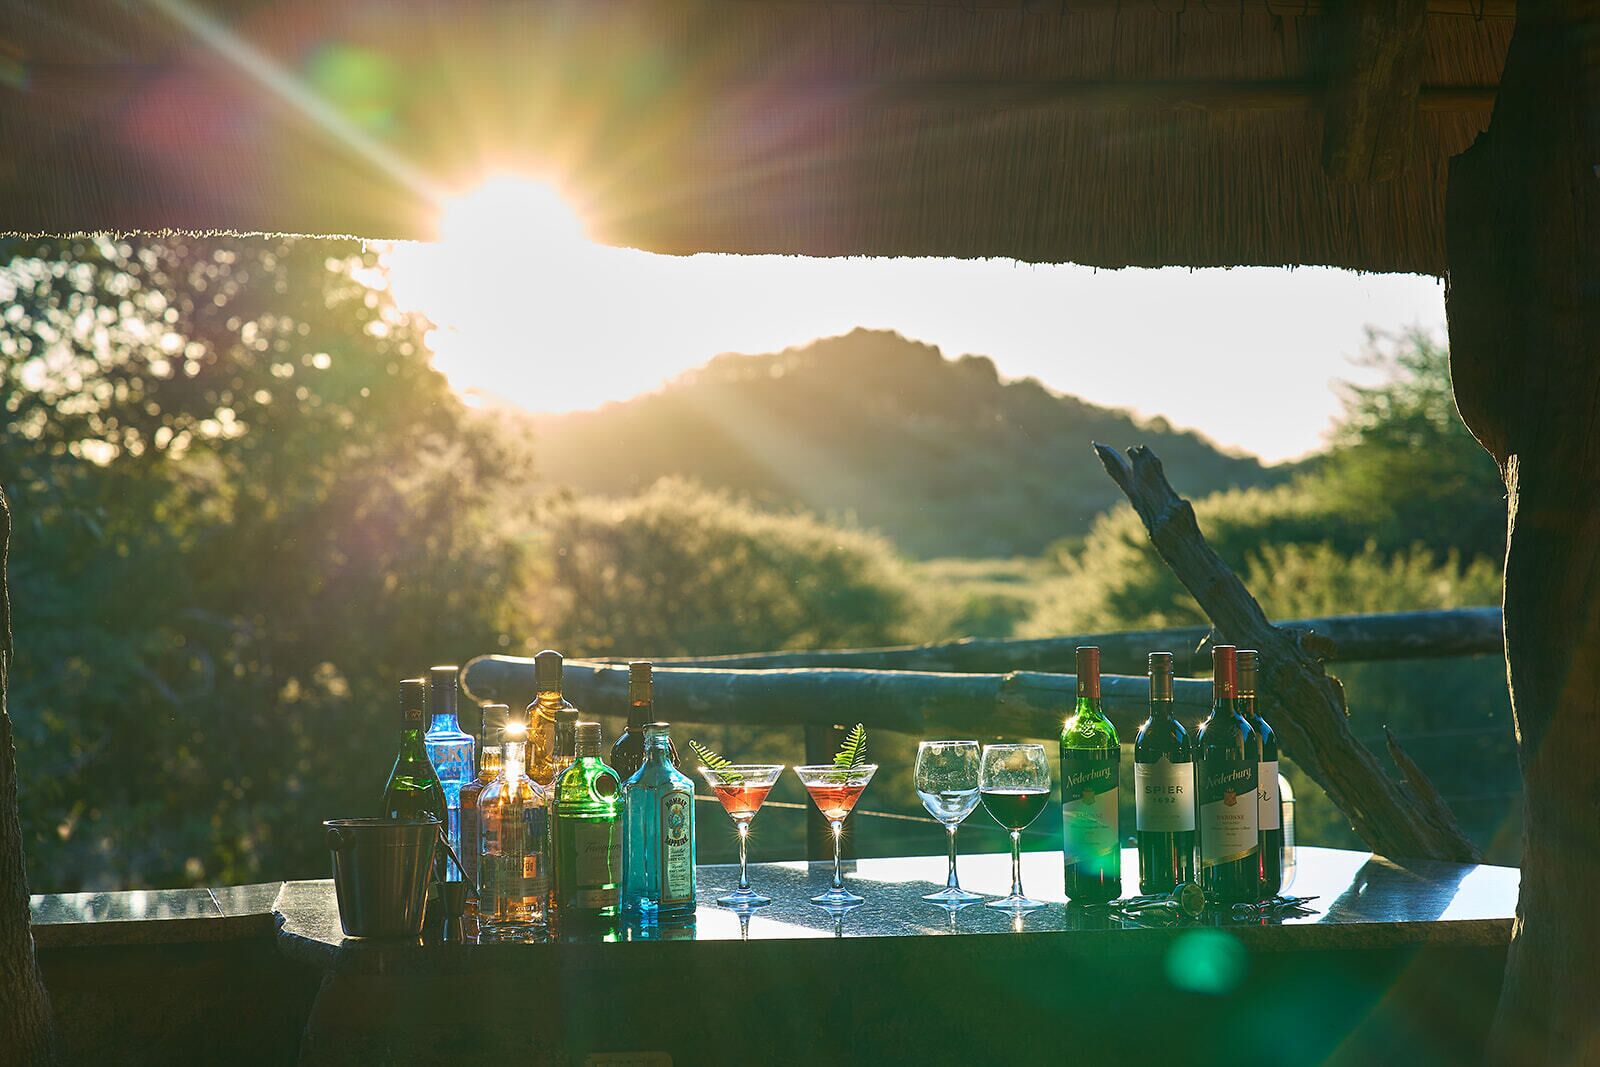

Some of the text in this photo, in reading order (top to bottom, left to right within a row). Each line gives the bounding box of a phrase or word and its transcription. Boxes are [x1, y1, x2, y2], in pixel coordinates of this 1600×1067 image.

[1066, 767, 1112, 790] Nederburg
[1144, 785, 1184, 794] SPIER
[1206, 767, 1252, 790] Nederburg
